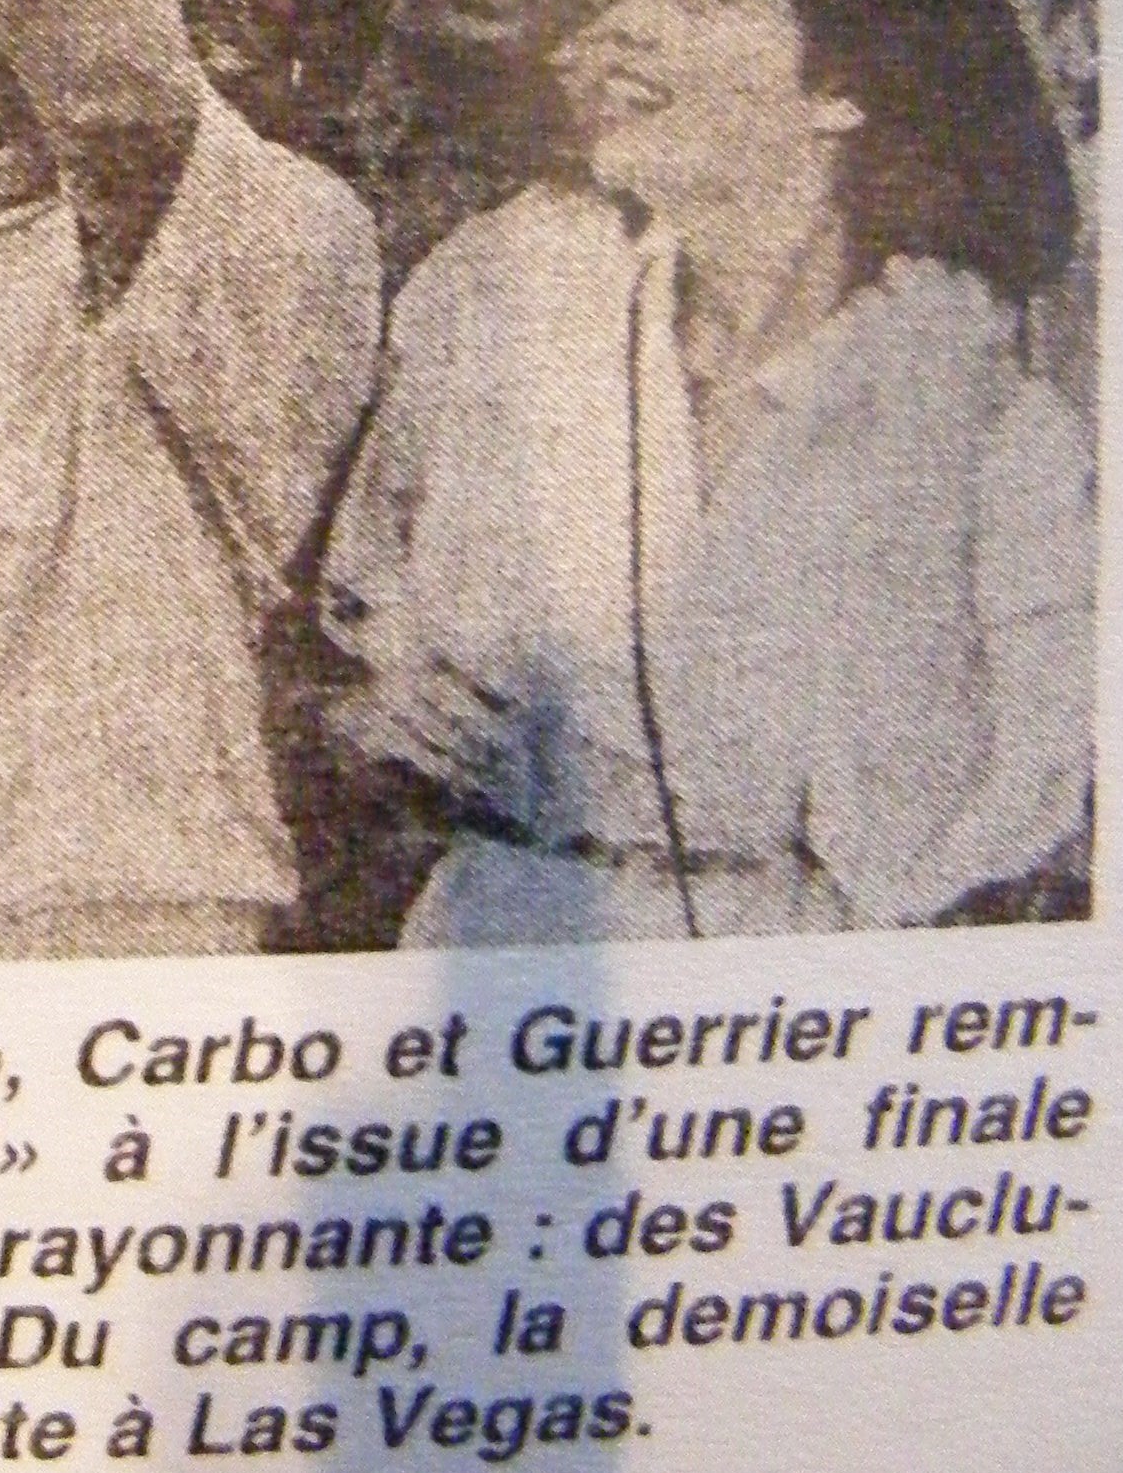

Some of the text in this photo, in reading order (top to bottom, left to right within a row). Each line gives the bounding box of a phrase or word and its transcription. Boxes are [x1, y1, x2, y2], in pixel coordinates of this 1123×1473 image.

[75, 1017, 344, 1090] Carbo
[384, 1012, 470, 1081] et
[509, 995, 873, 1077] Guerrier
[906, 995, 1100, 1063] rem-
[103, 1111, 153, 1184] à
[214, 1109, 505, 1181] l'issue
[563, 1096, 807, 1169] d'une
[862, 1075, 1095, 1152] finale
[528, 1213, 554, 1262] :
[583, 1190, 739, 1261] des
[781, 1170, 1092, 1249] Vauclu-
[172, 1311, 428, 1383] camp,
[493, 1288, 567, 1357] la
[626, 1260, 1089, 1352] demoiselle
[106, 1393, 155, 1461] à
[186, 1392, 340, 1458] Las
[378, 1384, 653, 1465] Vegas.
